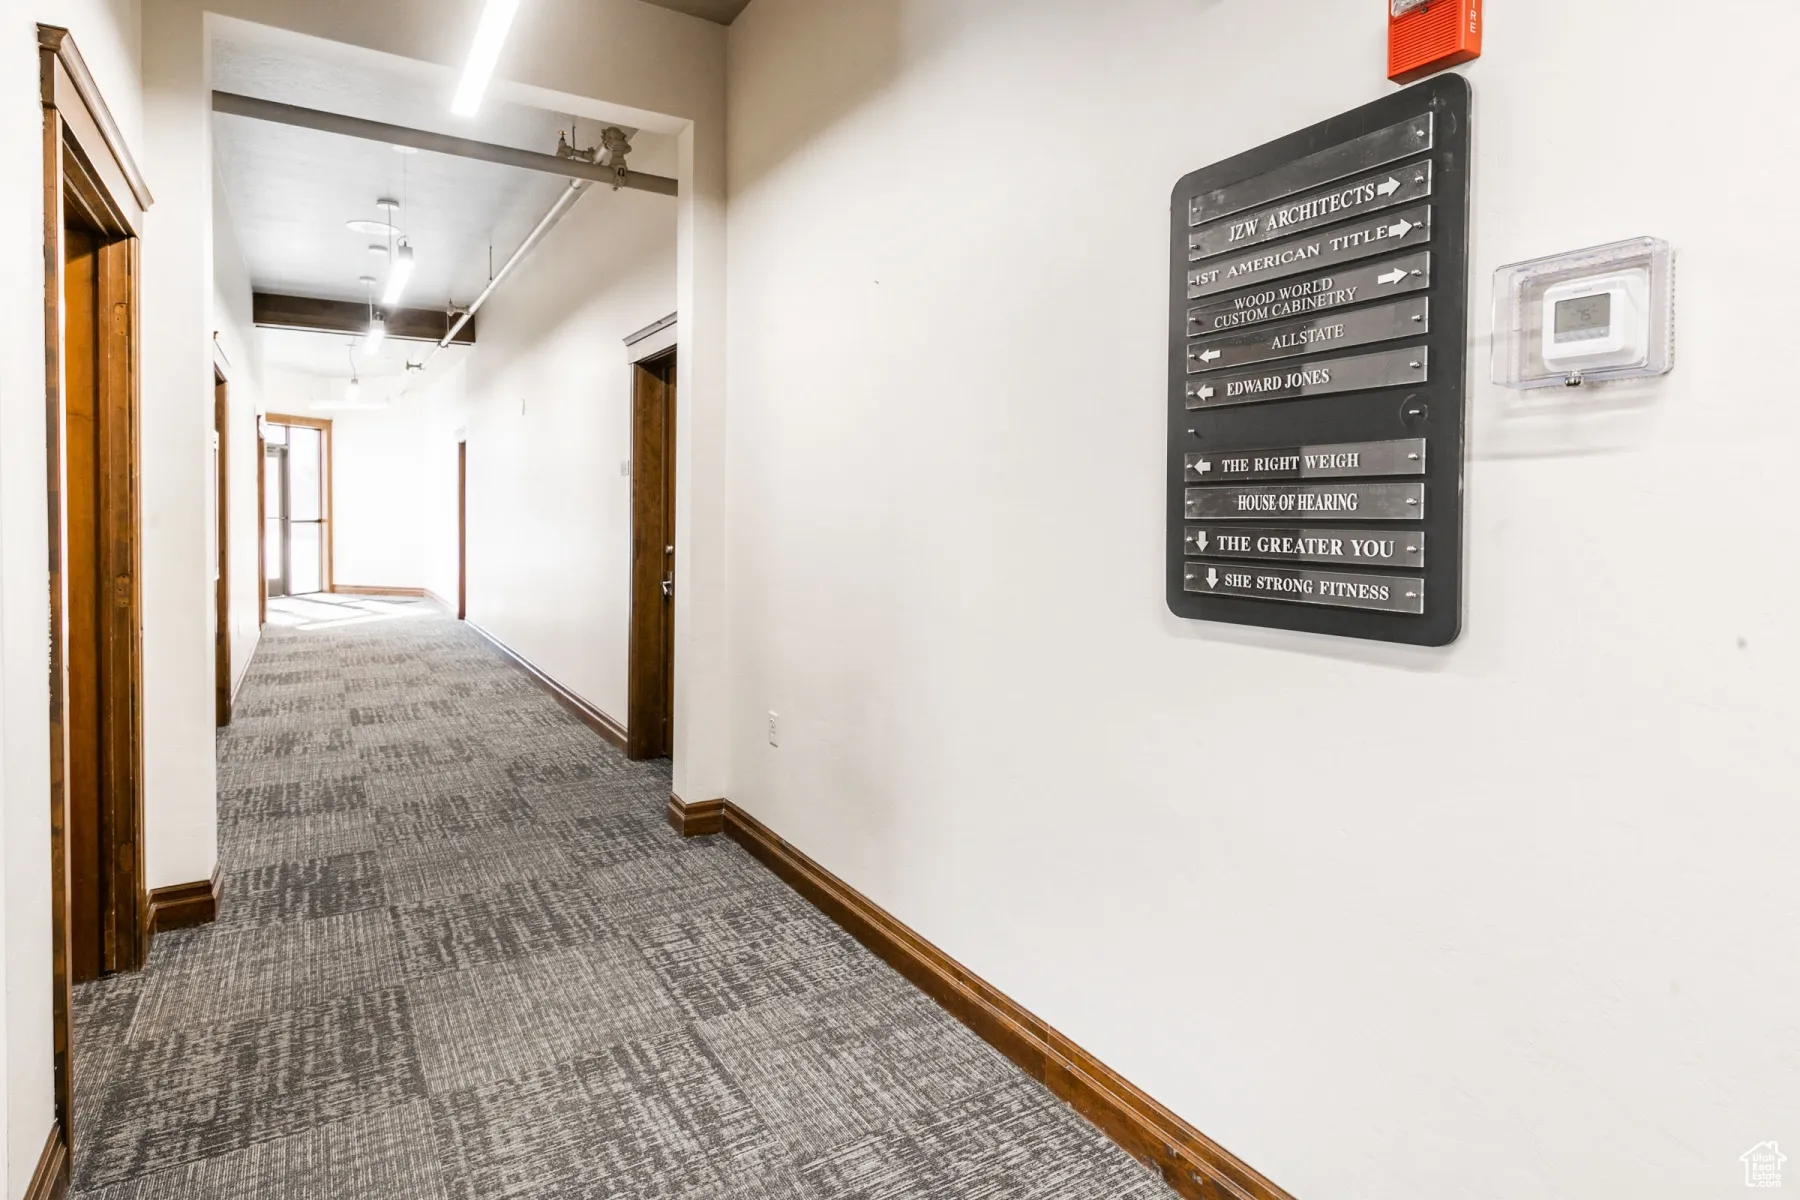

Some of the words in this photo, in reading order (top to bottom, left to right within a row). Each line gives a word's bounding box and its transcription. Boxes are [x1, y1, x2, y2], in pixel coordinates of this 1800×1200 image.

[1228, 218, 1259, 243] JZW
[1266, 182, 1375, 231] ARCHITECTS
[1227, 244, 1320, 278] AMERICAN
[1330, 225, 1388, 251] TITLE
[1214, 306, 1268, 328] CUSTOM
[1272, 287, 1357, 316] CABINETRY
[1234, 292, 1275, 310] WOOD
[1279, 278, 1332, 300] WORLD
[1272, 324, 1344, 349] ALLSTATE
[1227, 376, 1282, 396] EDWARD
[1284, 368, 1331, 387] JONES
[1222, 459, 1249, 473] THE
[1254, 456, 1300, 472] RIGHT
[1305, 452, 1360, 470] WEIGH
[1238, 494, 1277, 511] HOUSE
[1279, 494, 1295, 511] OF
[1298, 493, 1358, 511] HEARING
[1217, 535, 1251, 551] THE
[1257, 536, 1343, 555] GREATER
[1351, 540, 1395, 558] YOU
[1225, 574, 1252, 588] SHE
[1256, 576, 1313, 593] STRONG
[1320, 582, 1389, 600] FITNESS
